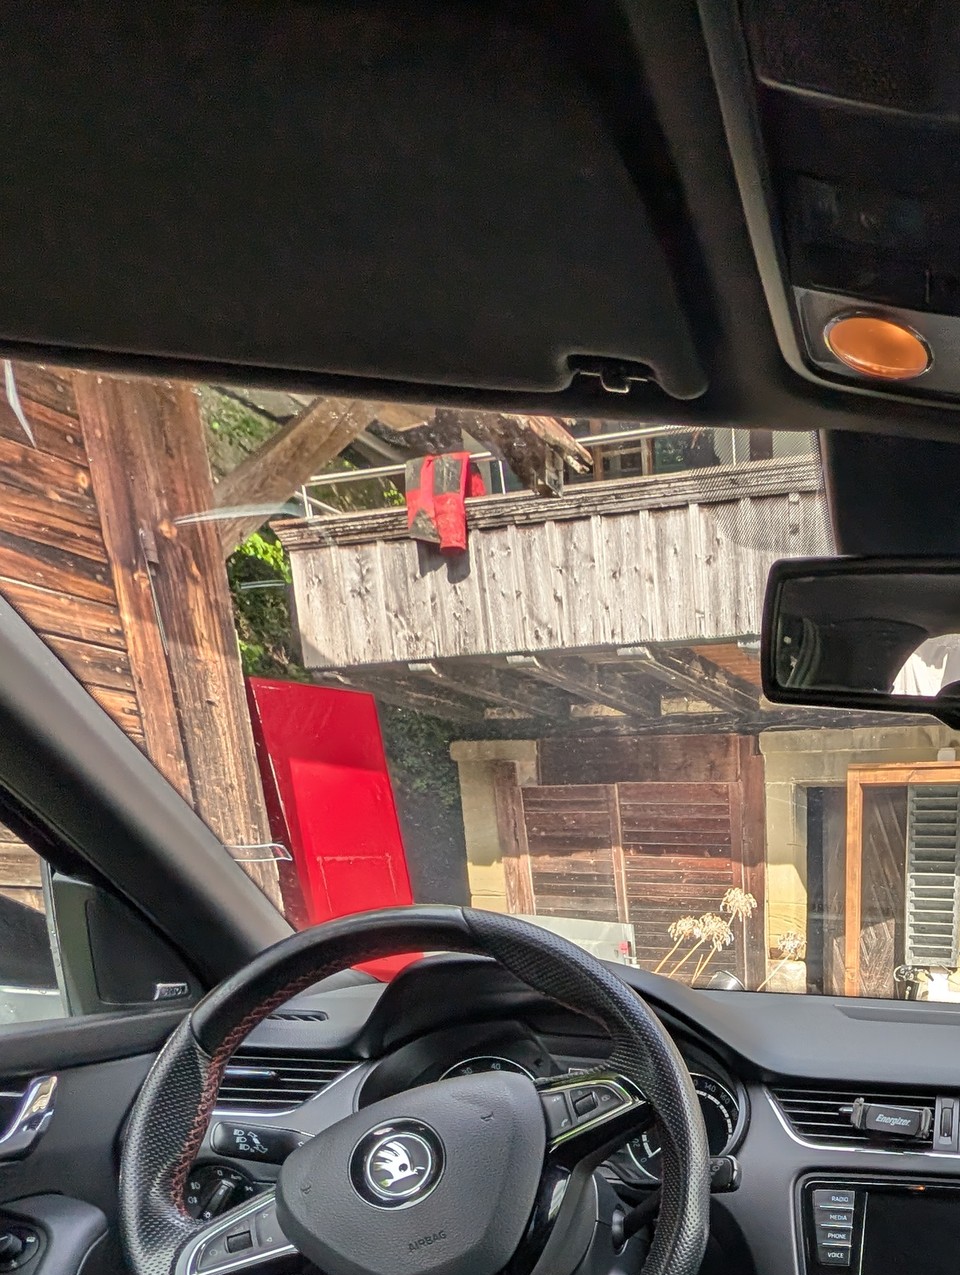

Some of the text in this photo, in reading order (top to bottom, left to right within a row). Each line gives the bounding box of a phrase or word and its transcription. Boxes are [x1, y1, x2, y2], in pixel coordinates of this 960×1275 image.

[704, 1082, 716, 1092] 140
[875, 1114, 910, 1126] Energizer
[408, 1230, 447, 1252] AIRBAG
